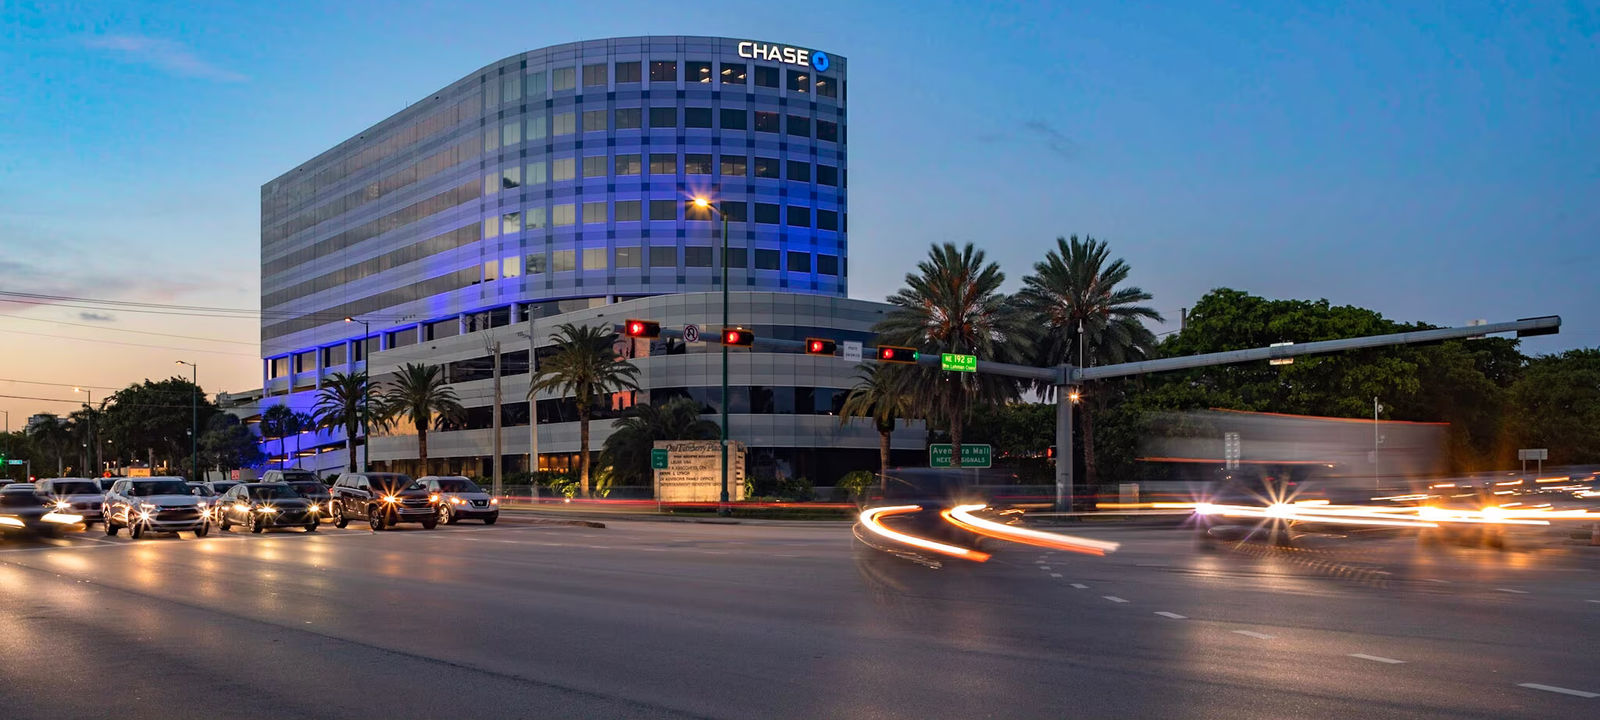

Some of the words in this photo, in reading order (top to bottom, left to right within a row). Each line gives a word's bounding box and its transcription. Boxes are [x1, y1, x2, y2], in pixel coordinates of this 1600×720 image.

[738, 41, 809, 66] CHASE
[945, 355, 953, 363] NE
[954, 354, 965, 364] 192
[933, 447, 969, 455] Avenra
[973, 447, 989, 455] Mall
